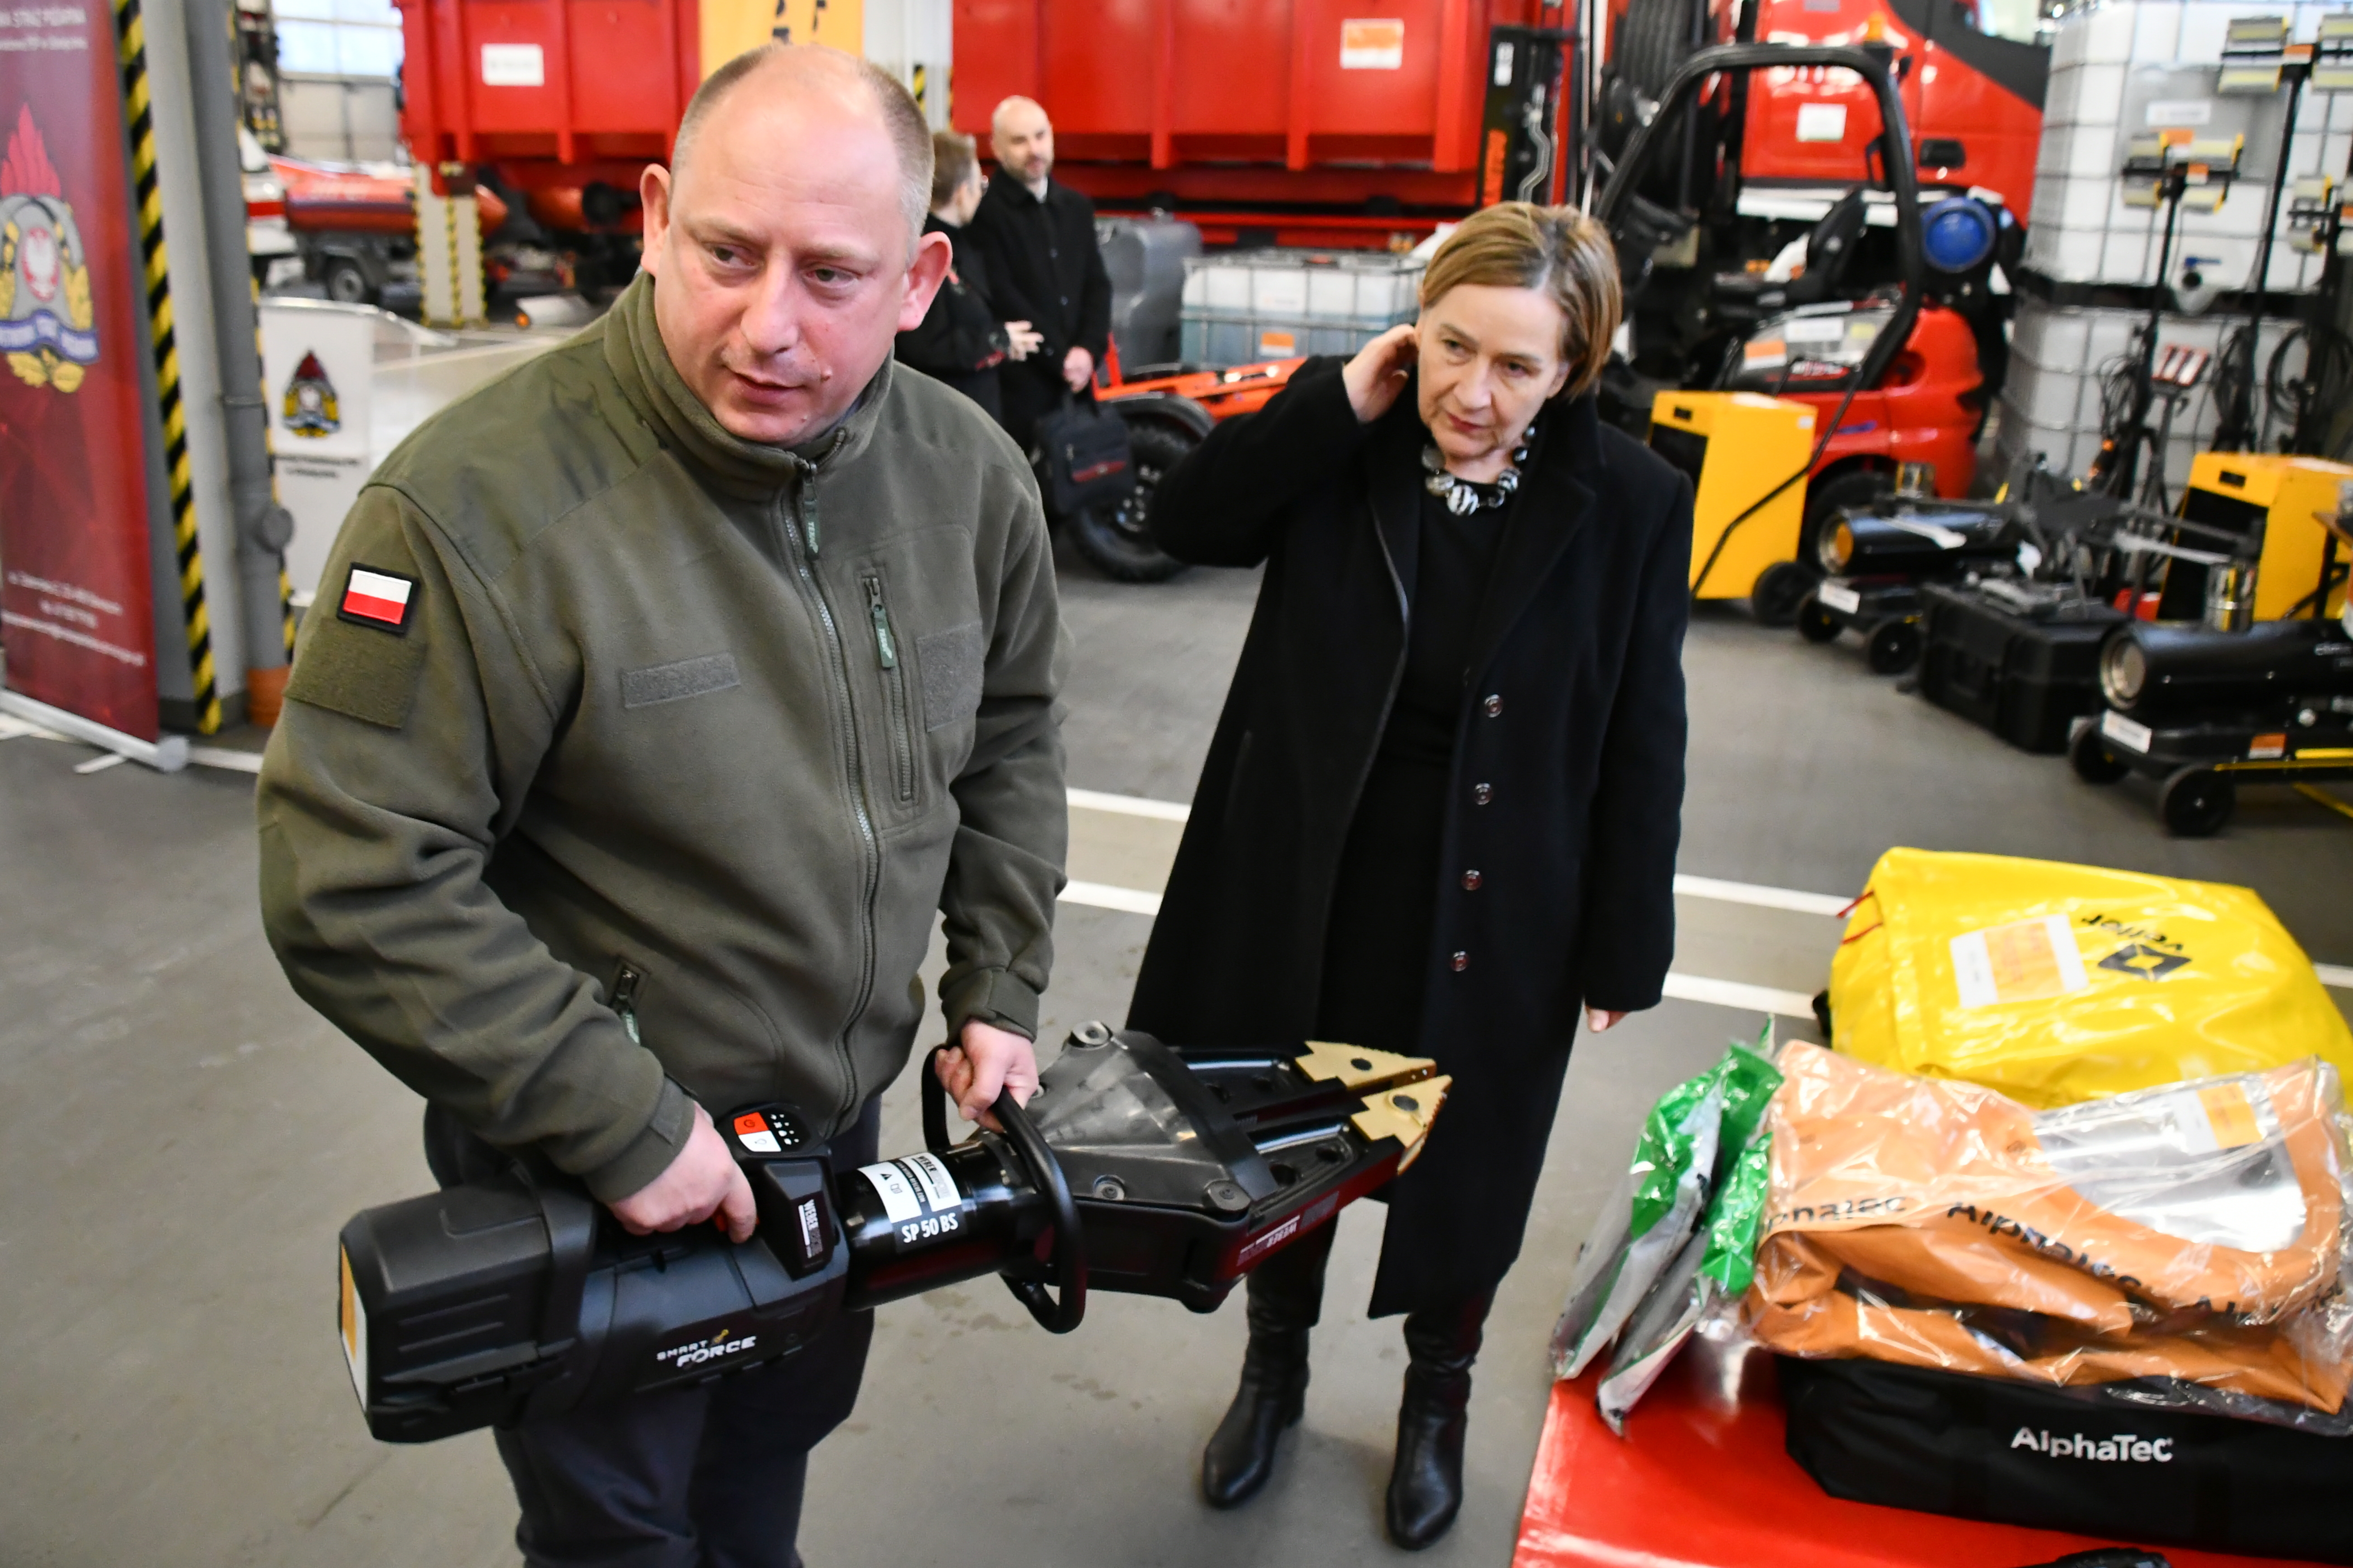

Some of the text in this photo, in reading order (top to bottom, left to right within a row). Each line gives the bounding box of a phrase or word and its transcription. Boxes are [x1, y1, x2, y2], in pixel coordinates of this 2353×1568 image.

[803, 1199, 819, 1231] WEBER
[901, 1212, 958, 1243] SP 50 BS
[656, 1339, 708, 1361] SMART
[676, 1335, 757, 1368] FORCE
[2010, 1426, 2173, 1463] AlphaTec
